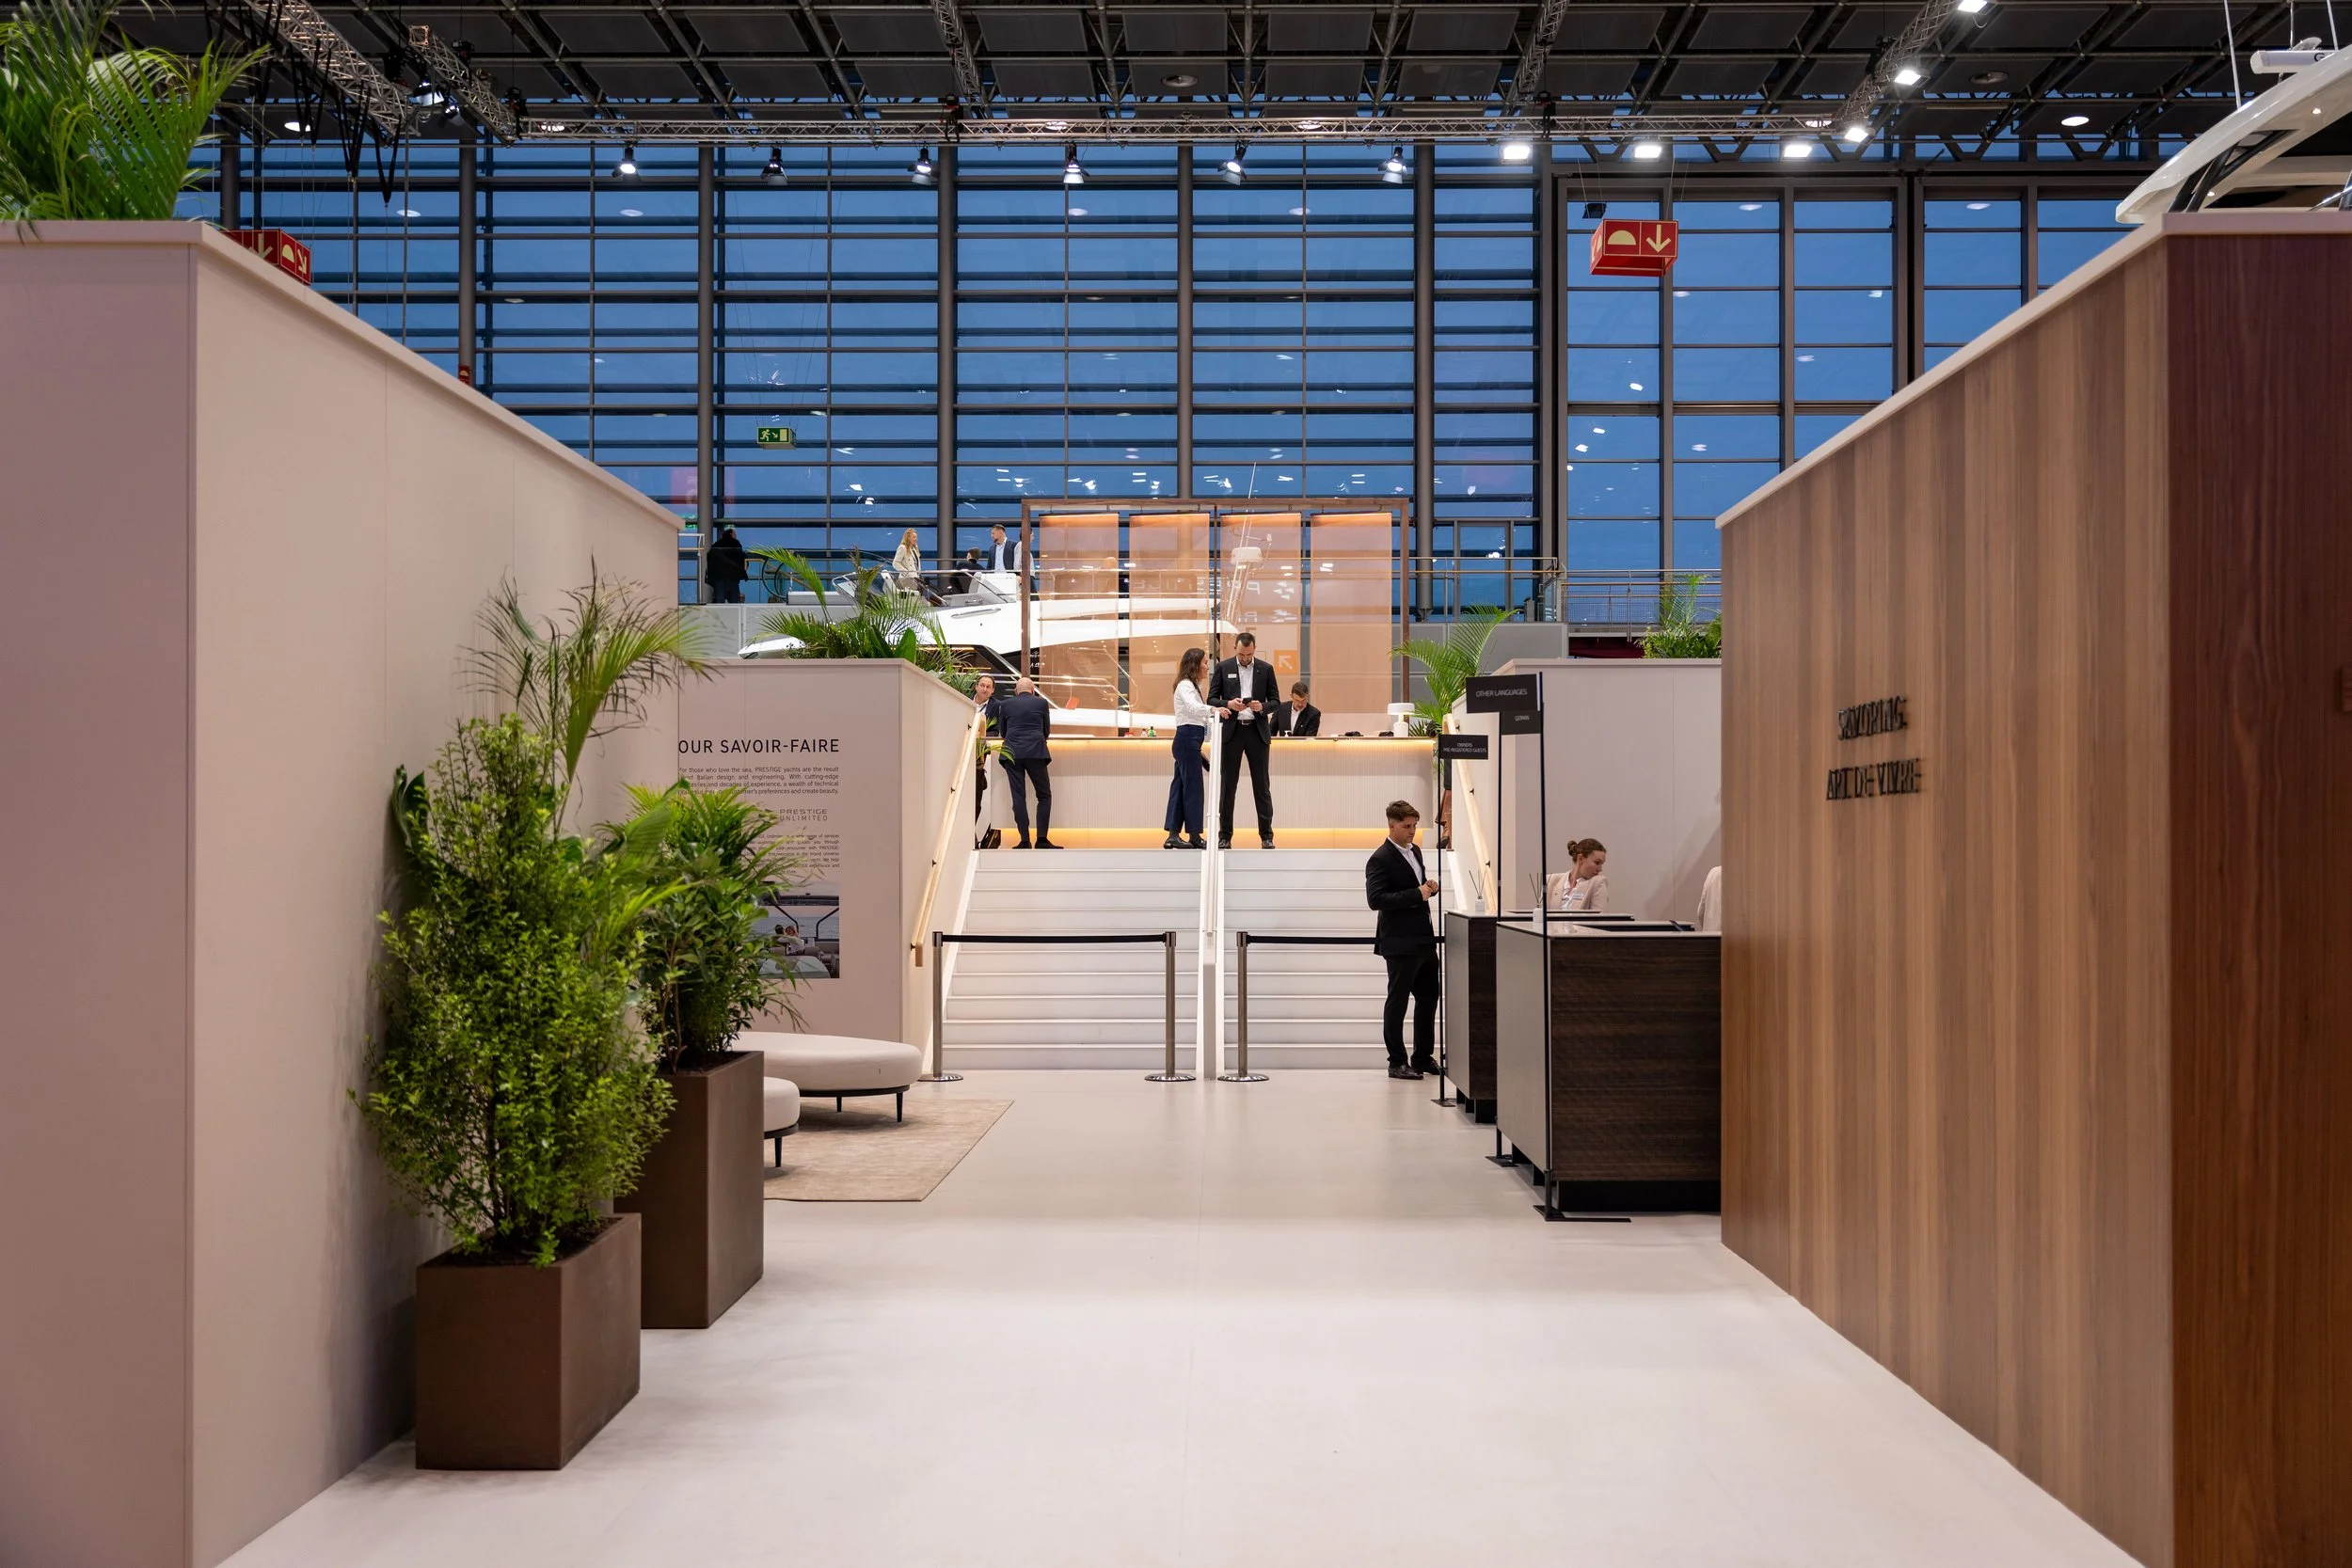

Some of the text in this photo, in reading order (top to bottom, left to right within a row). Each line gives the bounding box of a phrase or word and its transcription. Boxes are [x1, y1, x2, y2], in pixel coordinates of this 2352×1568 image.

[1475, 689, 1528, 698] OTHER LANGUAGES
[1837, 695, 1907, 740] SAVORING
[679, 739, 839, 753] OUR SAVOIR-FAIRE
[1826, 757, 1922, 800] ART DE VIVRE
